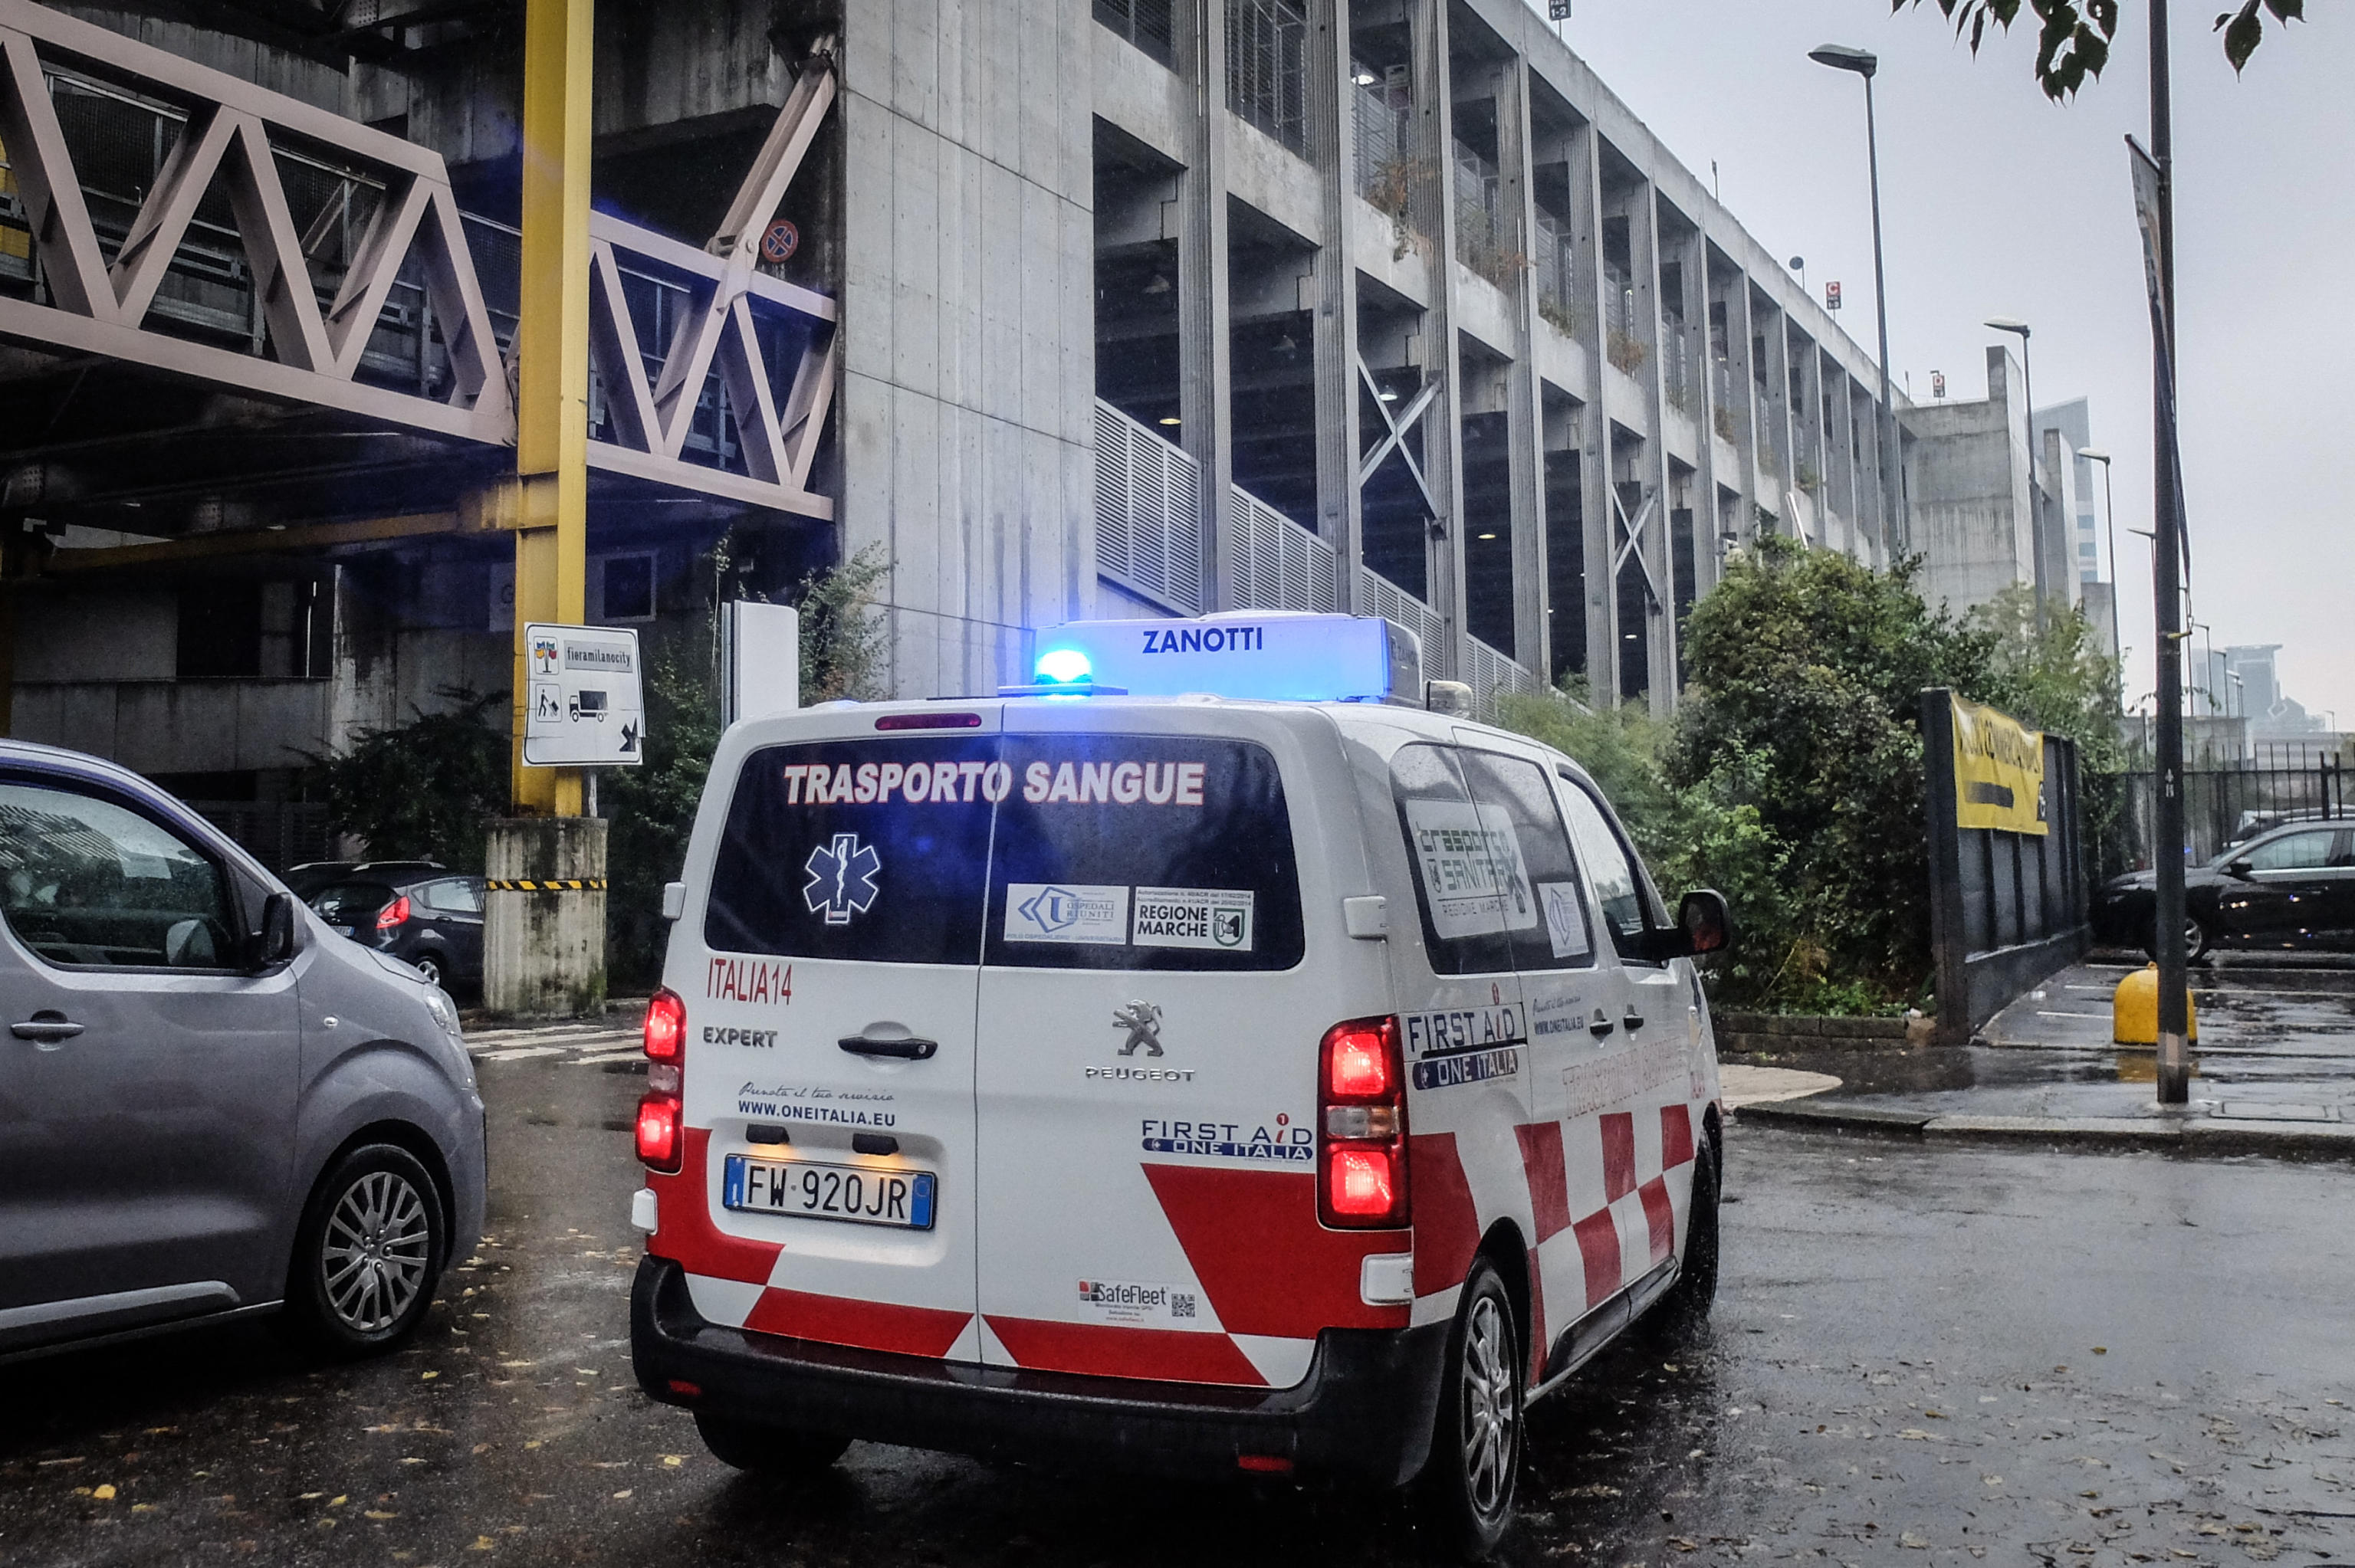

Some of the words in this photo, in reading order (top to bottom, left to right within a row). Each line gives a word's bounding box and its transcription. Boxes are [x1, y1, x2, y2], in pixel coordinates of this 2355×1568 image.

[1551, 6, 1566, 17] 1-2
[1142, 627, 1263, 654] ZANOTTI
[567, 647, 631, 668] fieramilanocity
[783, 761, 1010, 805] TRASPORTO
[1023, 761, 1206, 806] SANGUE
[1139, 904, 1208, 921] REGIONE
[1138, 920, 1207, 937] MARCHE
[703, 1025, 778, 1048] EXPERT
[1407, 1012, 1475, 1053] FIRST
[1085, 1065, 1195, 1082] PEUGEOT
[1437, 1057, 1473, 1086] ONE
[1476, 1050, 1517, 1080] ITALIA
[738, 1100, 895, 1127] WWW.ONEITALIA.EU
[1141, 1120, 1239, 1141] FIRST
[1173, 1140, 1223, 1155] ONE
[1233, 1142, 1306, 1160] ITALIA
[1096, 1283, 1167, 1305] SafeFleet
